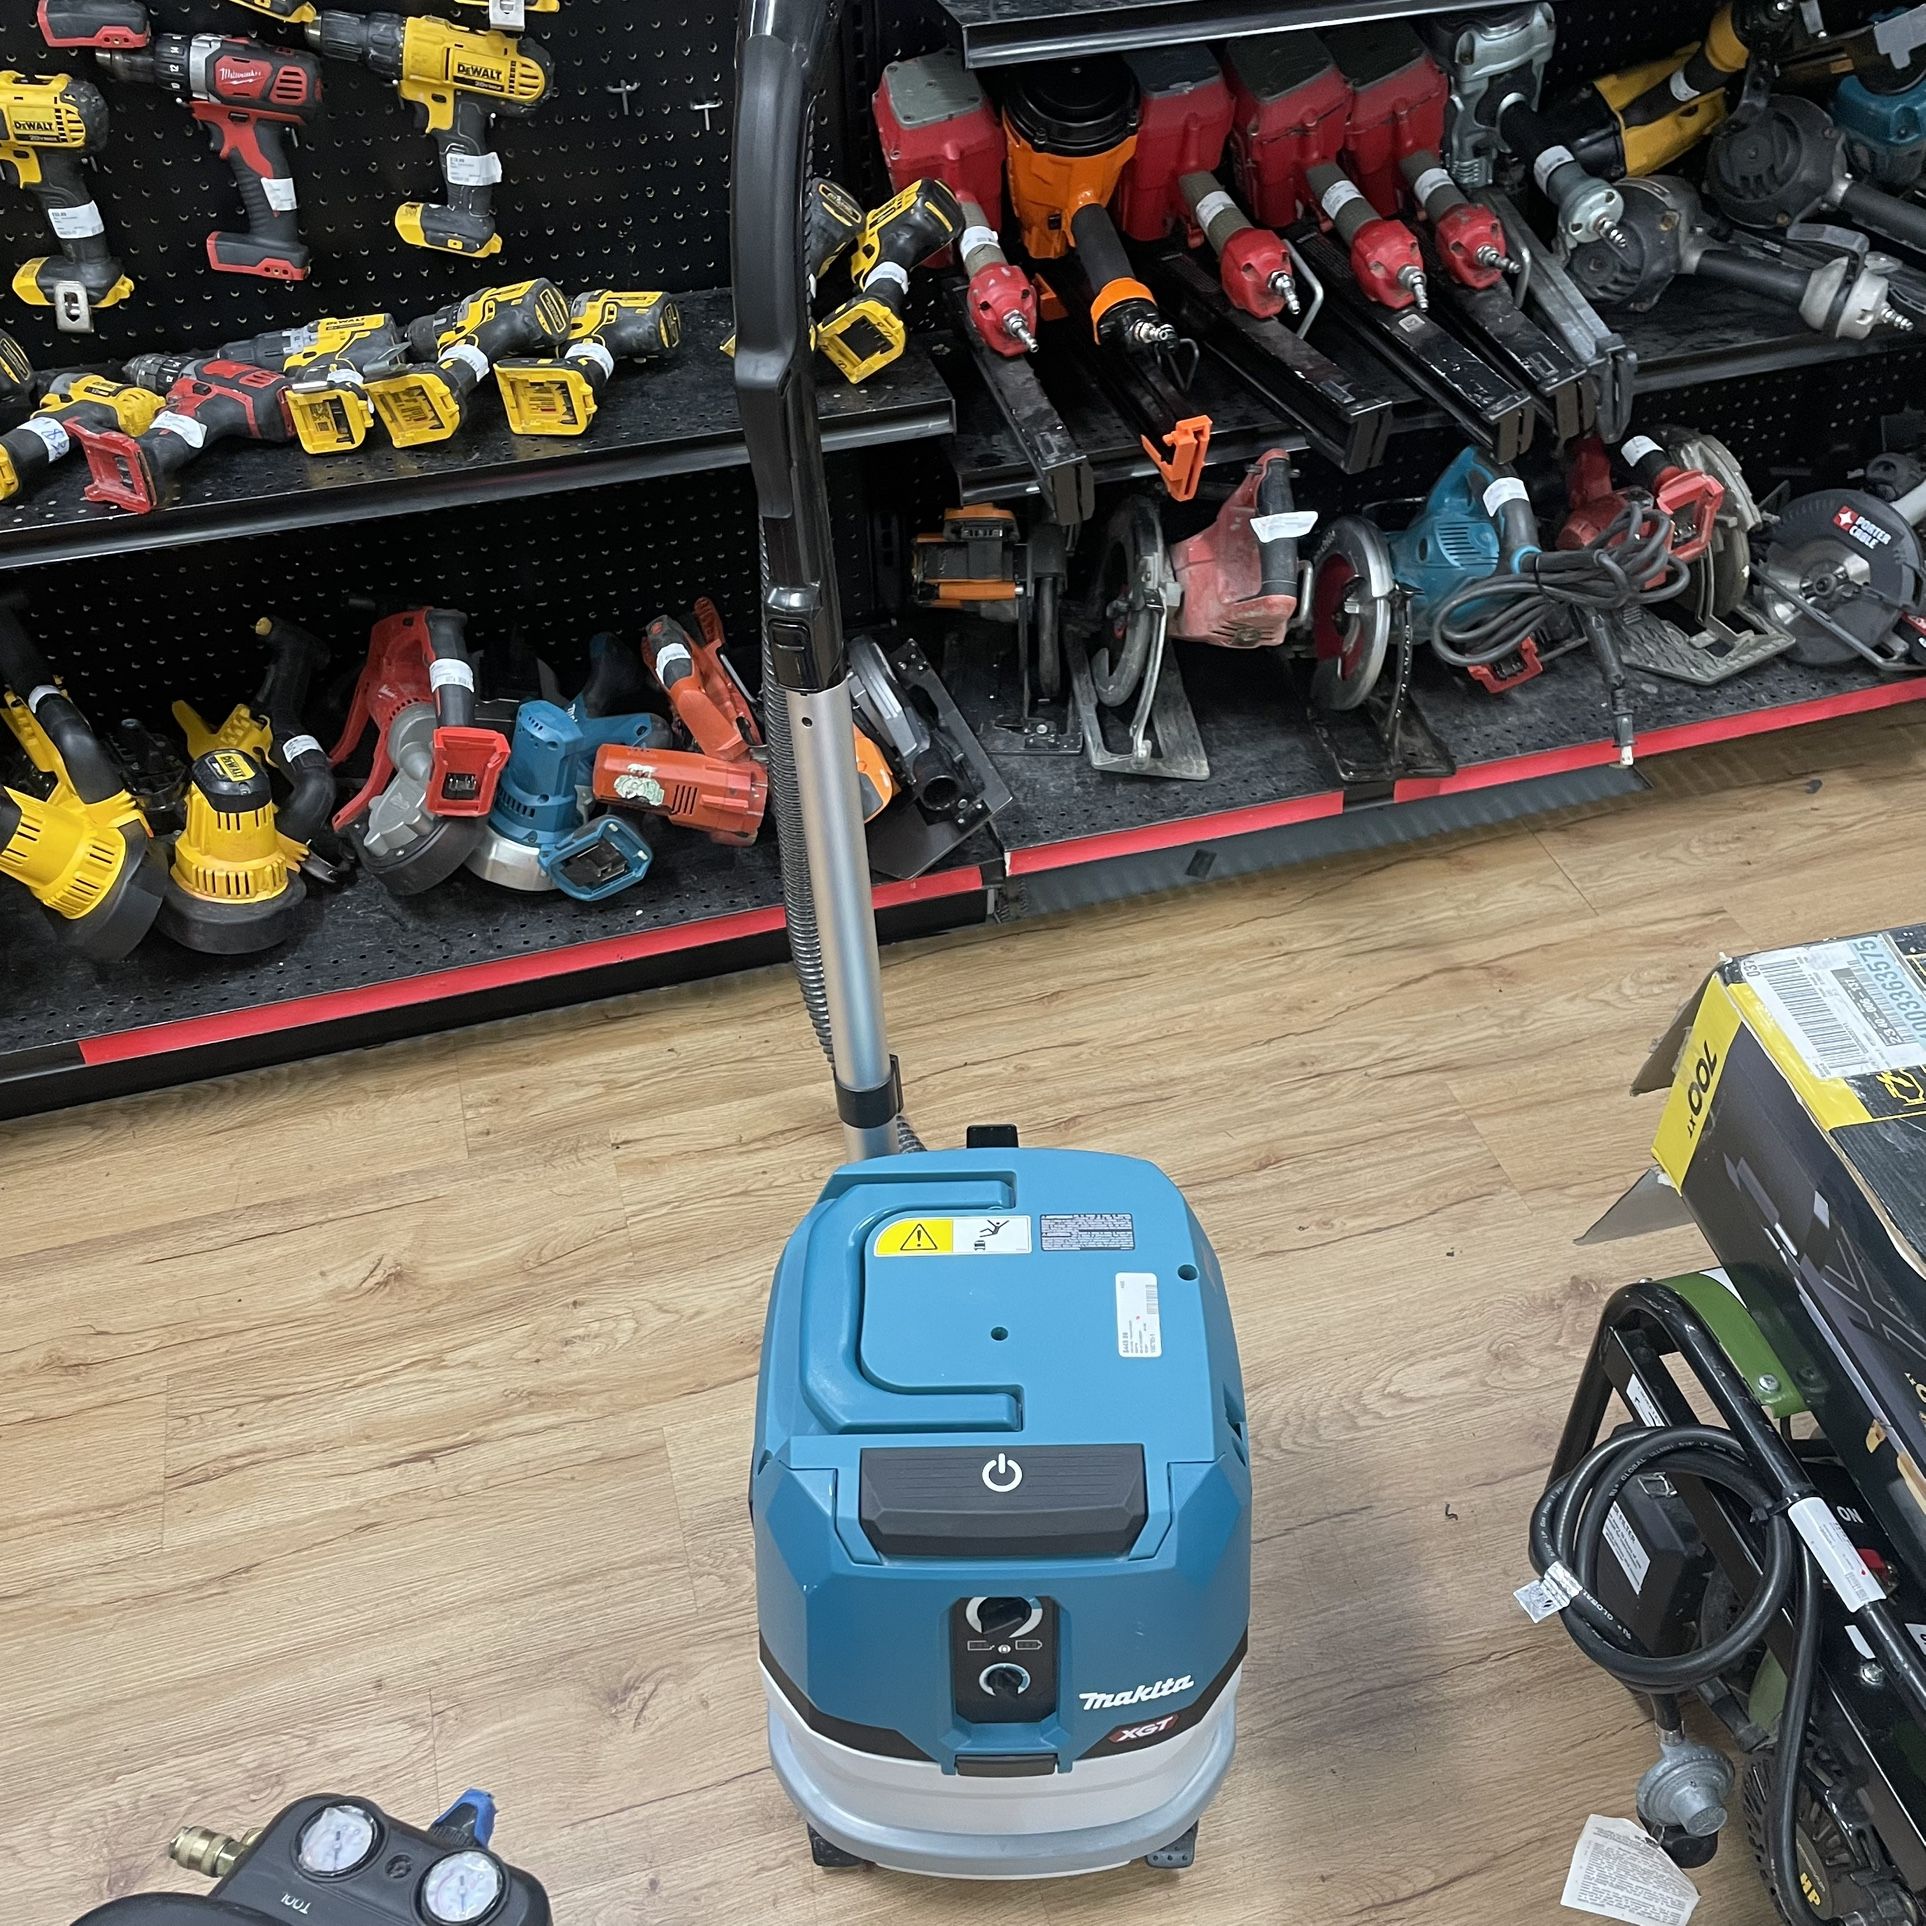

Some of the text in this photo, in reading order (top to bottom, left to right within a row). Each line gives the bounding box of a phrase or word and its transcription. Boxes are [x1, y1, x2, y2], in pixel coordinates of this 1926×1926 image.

[457, 63, 502, 80] DEWALT
[14, 121, 53, 131] DEWALT
[1849, 525, 1879, 550] CABLE
[1856, 516, 1892, 545] PORTER
[1688, 1040, 1717, 1116] 700
[1621, 1458, 1647, 1481] GLOBAL
[1836, 1506, 1864, 1524] ON
[1117, 1716, 1174, 1742] XGT
[1800, 1872, 1821, 1906] HP
